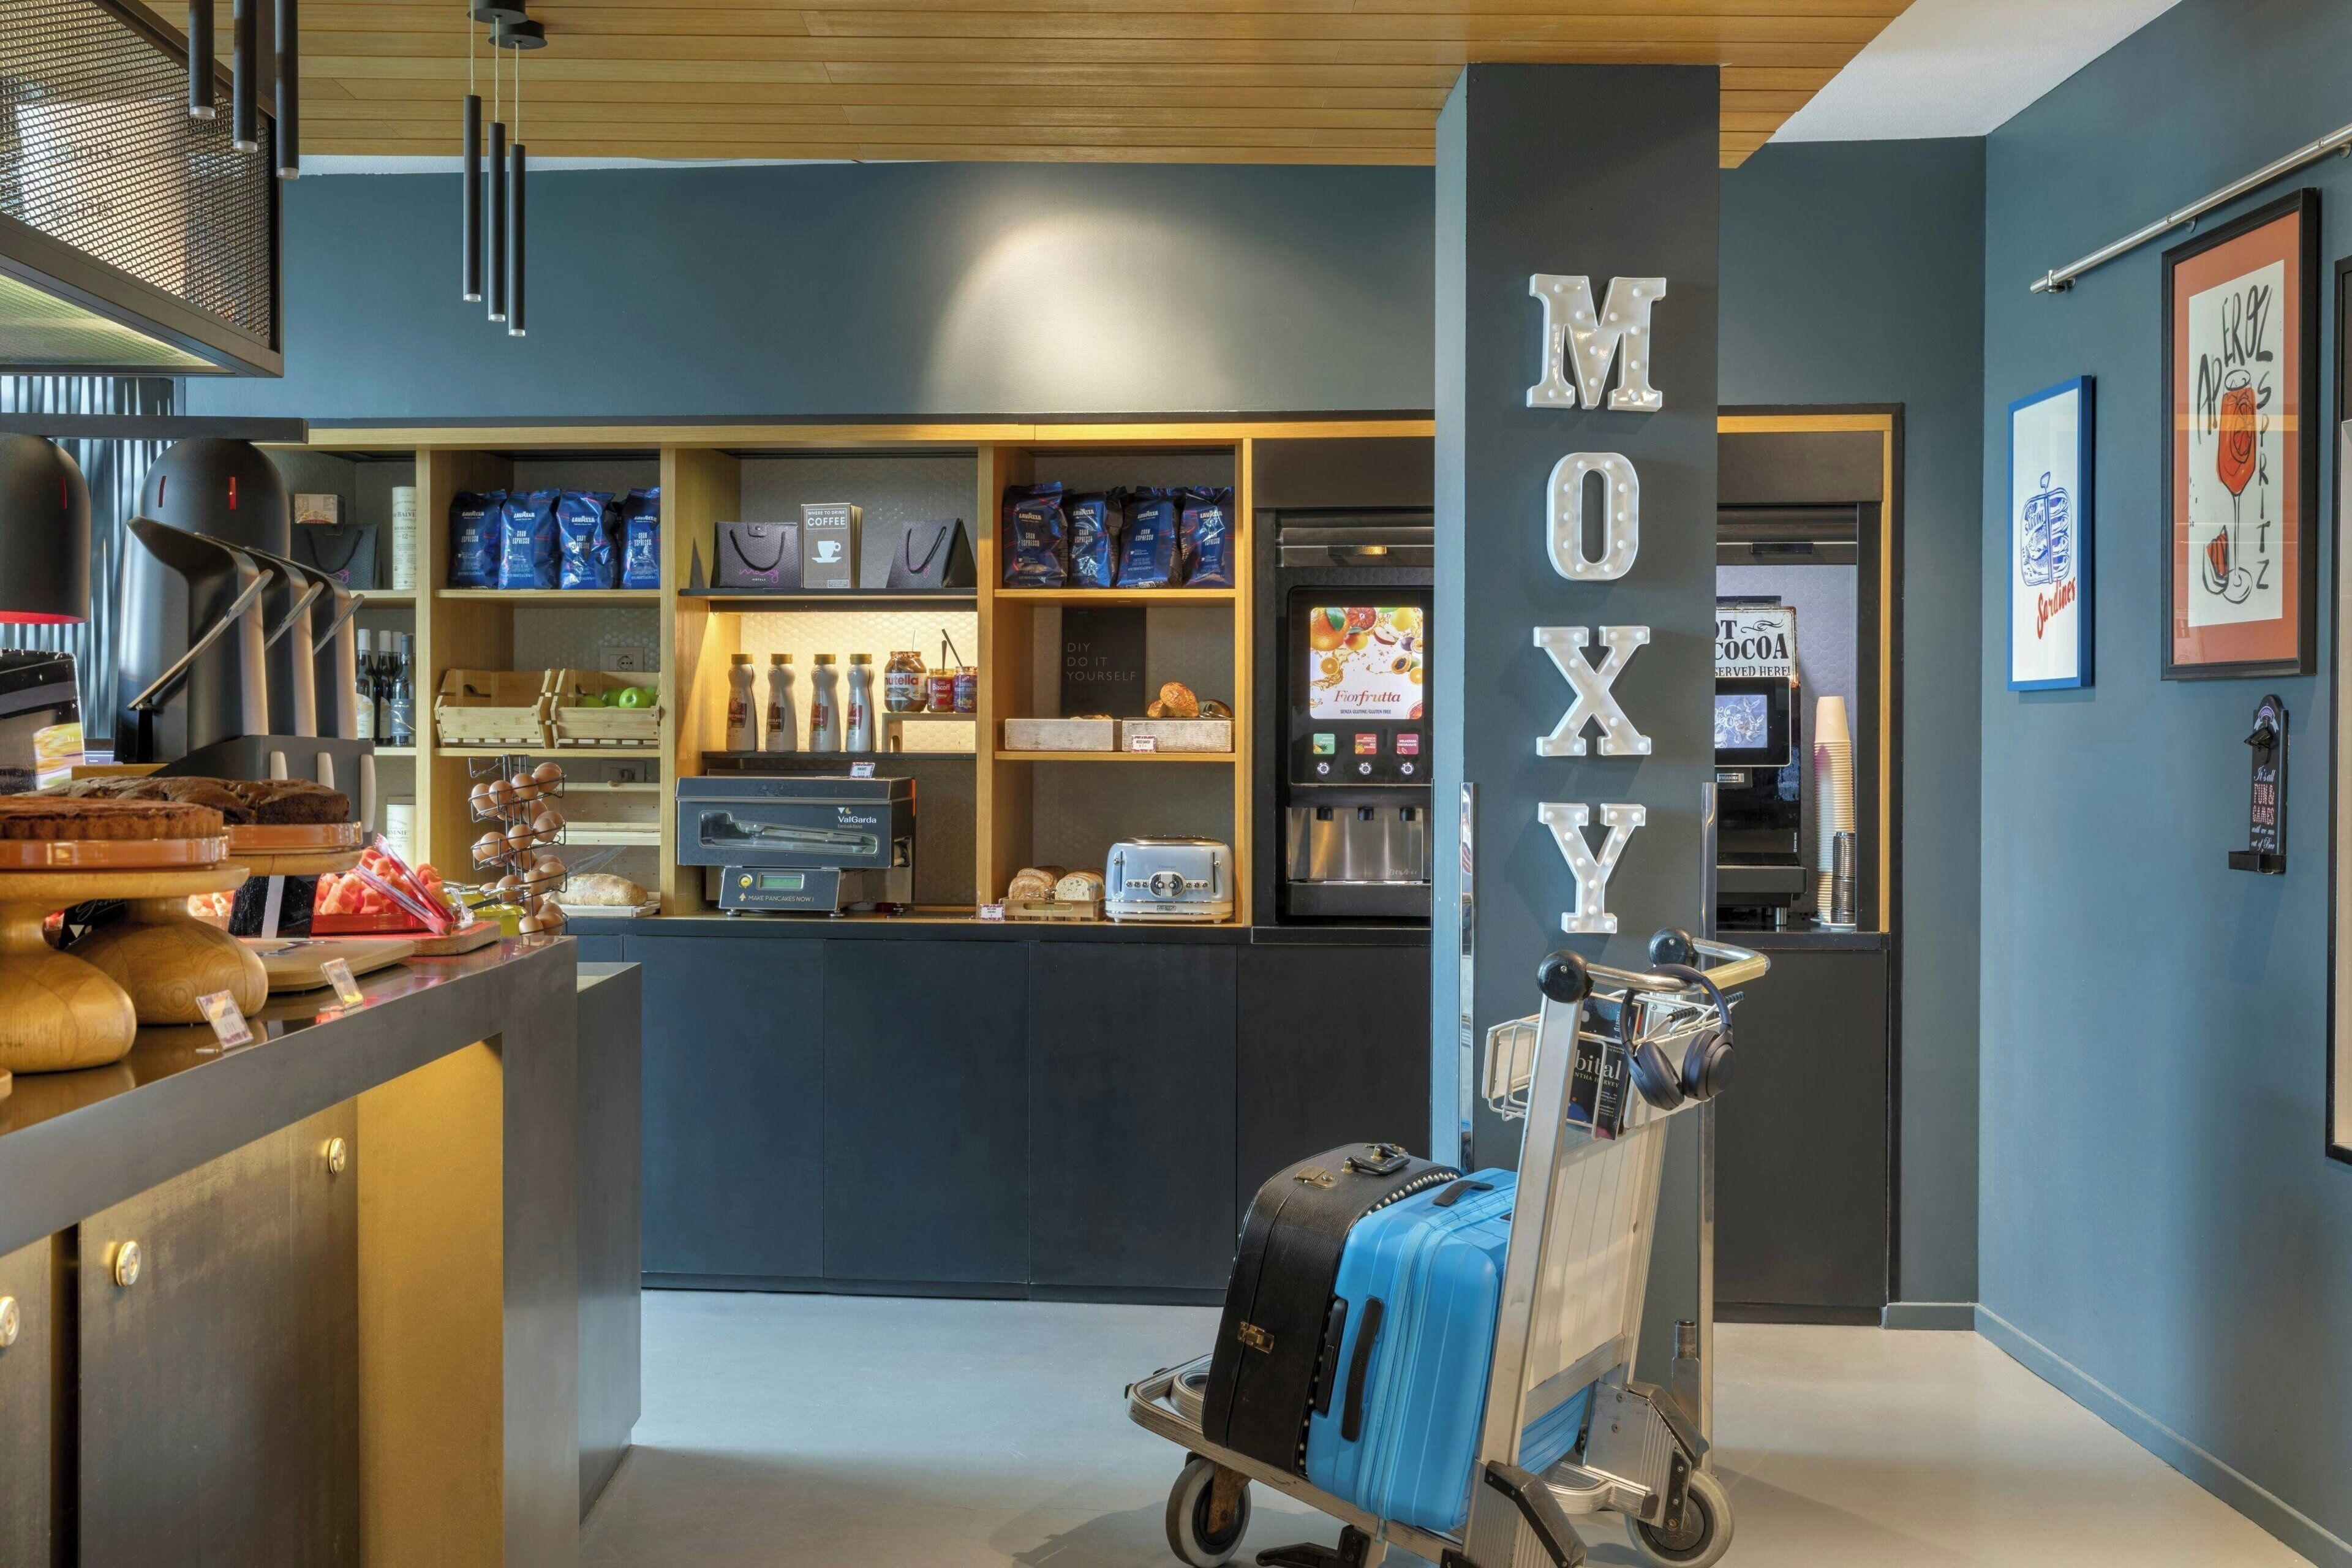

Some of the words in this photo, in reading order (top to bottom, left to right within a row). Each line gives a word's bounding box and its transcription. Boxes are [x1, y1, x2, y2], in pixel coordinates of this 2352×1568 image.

[2255, 370, 2273, 590] SPRITZ
[1137, 510, 1158, 519] LAVAZZA
[808, 517, 845, 526] COFFEE
[1526, 274, 1667, 933] MOXY
[2037, 576, 2075, 639] Sardines
[1716, 620, 1737, 639] T
[1068, 643, 1090, 652] DIY
[1068, 657, 1088, 666] DO
[1096, 657, 1107, 666] IT
[1066, 671, 1136, 680] YOURSELF
[1759, 666, 1790, 676] HERE!
[885, 674, 919, 685] nutella
[1334, 690, 1401, 706] Fiorfrutta
[2267, 769, 2275, 782] all
[2254, 783, 2267, 805] FUN
[2268, 785, 2275, 805] &
[2253, 805, 2274, 826] GAMES
[2258, 839, 2263, 851] of
[2264, 837, 2275, 850] Beer
[1594, 1076, 1620, 1088] HRVEY
